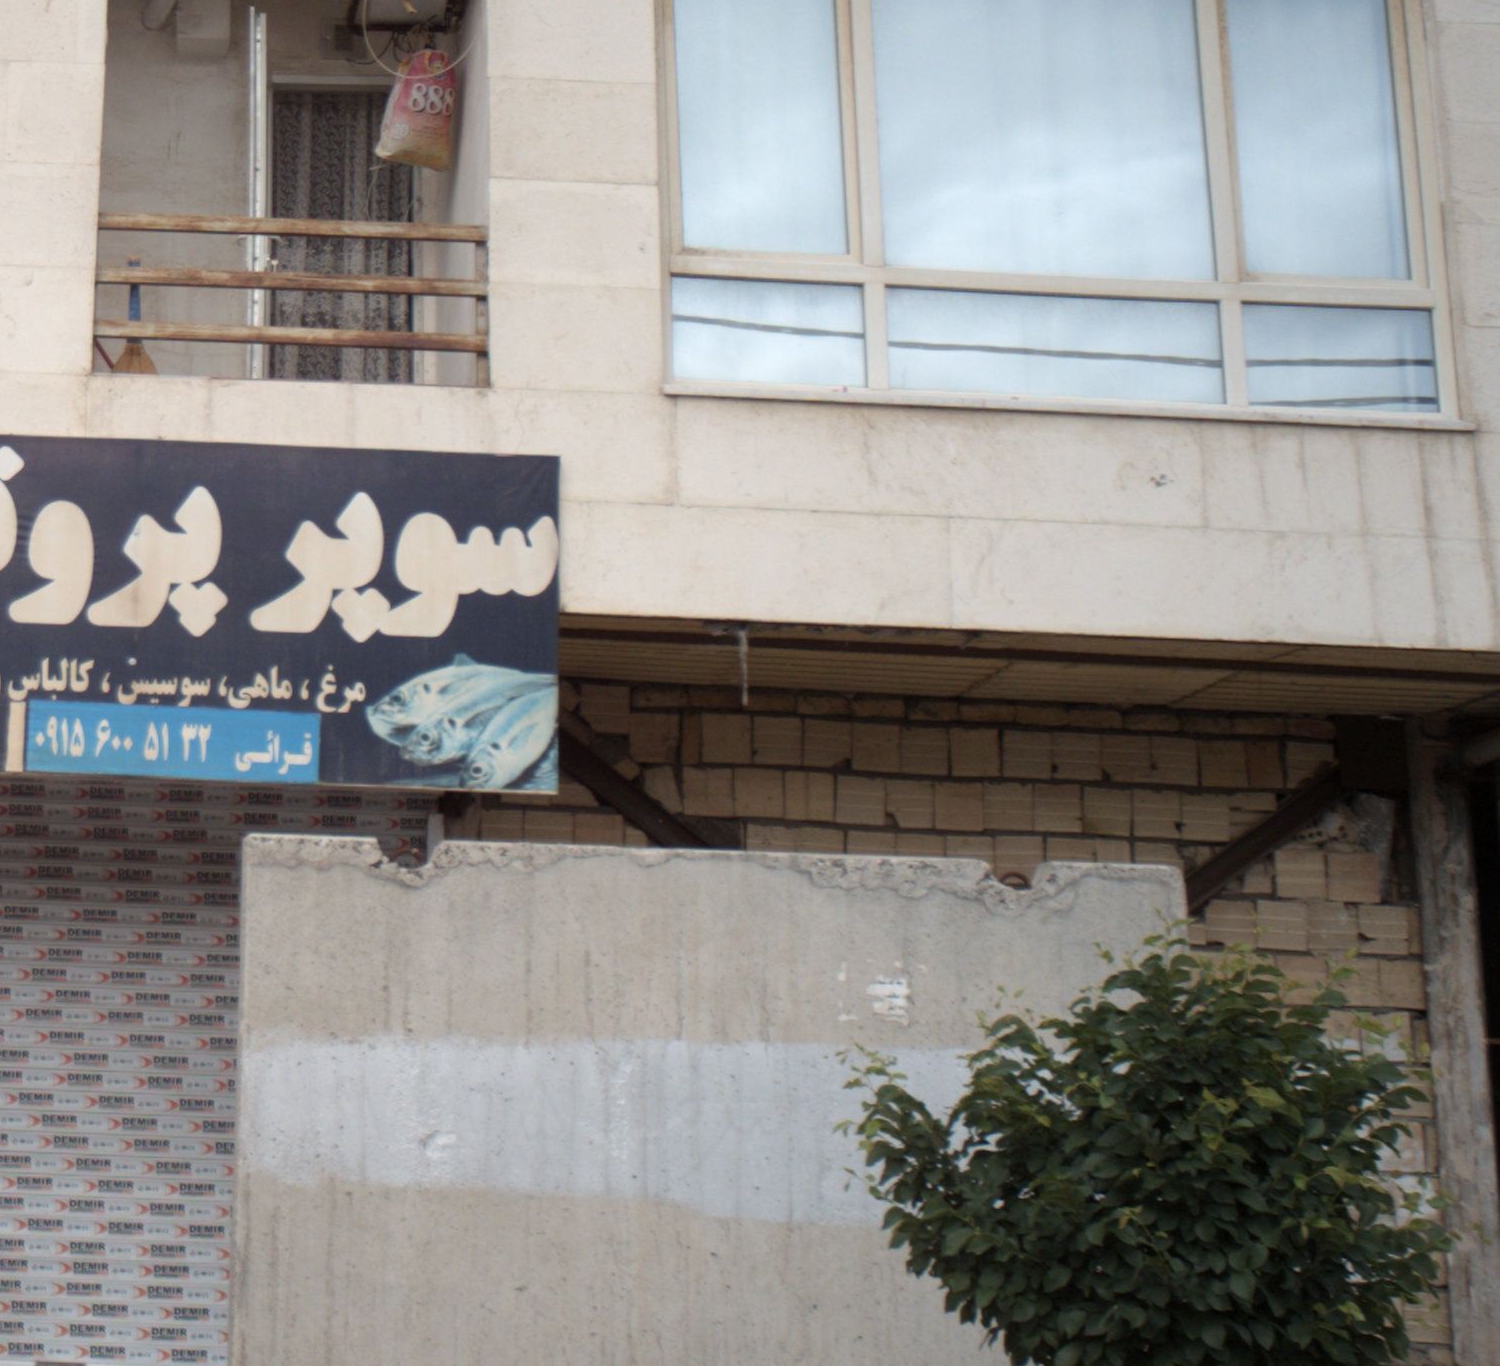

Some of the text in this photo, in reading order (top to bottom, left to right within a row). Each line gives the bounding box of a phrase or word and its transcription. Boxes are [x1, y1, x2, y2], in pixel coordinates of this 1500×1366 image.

[410, 83, 455, 116] 888
[250, 490, 560, 643] سوپر
[6, 657, 95, 702] کالباس
[169, 789, 205, 799] DEMIR
[165, 810, 201, 820] DEMIR
[44, 846, 80, 856] DEMIR
[201, 852, 237, 862] DEMIR
[196, 871, 232, 881] DEMIR
[46, 886, 82, 896] DEMIR
[125, 890, 161, 900] DEMIR
[161, 911, 197, 921] DEMIR
[67, 928, 103, 938] DEMIR
[48, 948, 84, 958] DEMIR
[190, 974, 226, 984] DEMIR
[55, 989, 91, 999] DEMIR
[108, 1010, 144, 1020] DEMIR
[189, 1013, 225, 1023] DEMIR
[129, 1034, 165, 1044] DEMIR
[73, 1052, 109, 1062] DEMIR
[153, 1055, 189, 1065] DEMIR
[148, 1076, 184, 1086] DEMIR
[19, 1092, 55, 1102] DEMIR
[99, 1095, 135, 1105] DEMIR
[179, 1098, 215, 1108] DEMIR
[42, 1114, 78, 1124] DEMIR
[122, 1117, 158, 1127] DEMIR
[53, 1135, 89, 1145] DEMIR
[134, 1138, 170, 1148] DEMIR
[76, 1158, 112, 1168] DEMIR
[156, 1161, 192, 1171] DEMIR
[17, 1176, 53, 1186] DEMIR
[98, 1179, 134, 1189] DEMIR
[179, 1182, 215, 1192] DEMIR
[69, 1199, 105, 1209] DEMIR
[150, 1202, 186, 1212] DEMIR
[28, 1218, 64, 1228] DEMIR
[108, 1221, 144, 1231] DEMIR
[189, 1224, 225, 1234] DEMIR
[70, 1241, 106, 1251] DEMIR
[151, 1244, 187, 1254] DEMIR
[73, 1261, 109, 1271] DEMIR
[154, 1264, 190, 1274] DEMIR
[67, 1282, 103, 1292] DEMIR
[148, 1285, 184, 1295] DEMIR
[11, 1300, 47, 1310] DEMIR
[92, 1303, 128, 1313] DEMIR
[174, 1307, 210, 1317] DEMIR
[70, 1324, 106, 1334] DEMIR
[151, 1327, 187, 1337] DEMIR
[8, 1342, 44, 1352] DEMIR
[90, 1345, 126, 1355] DEMIR
